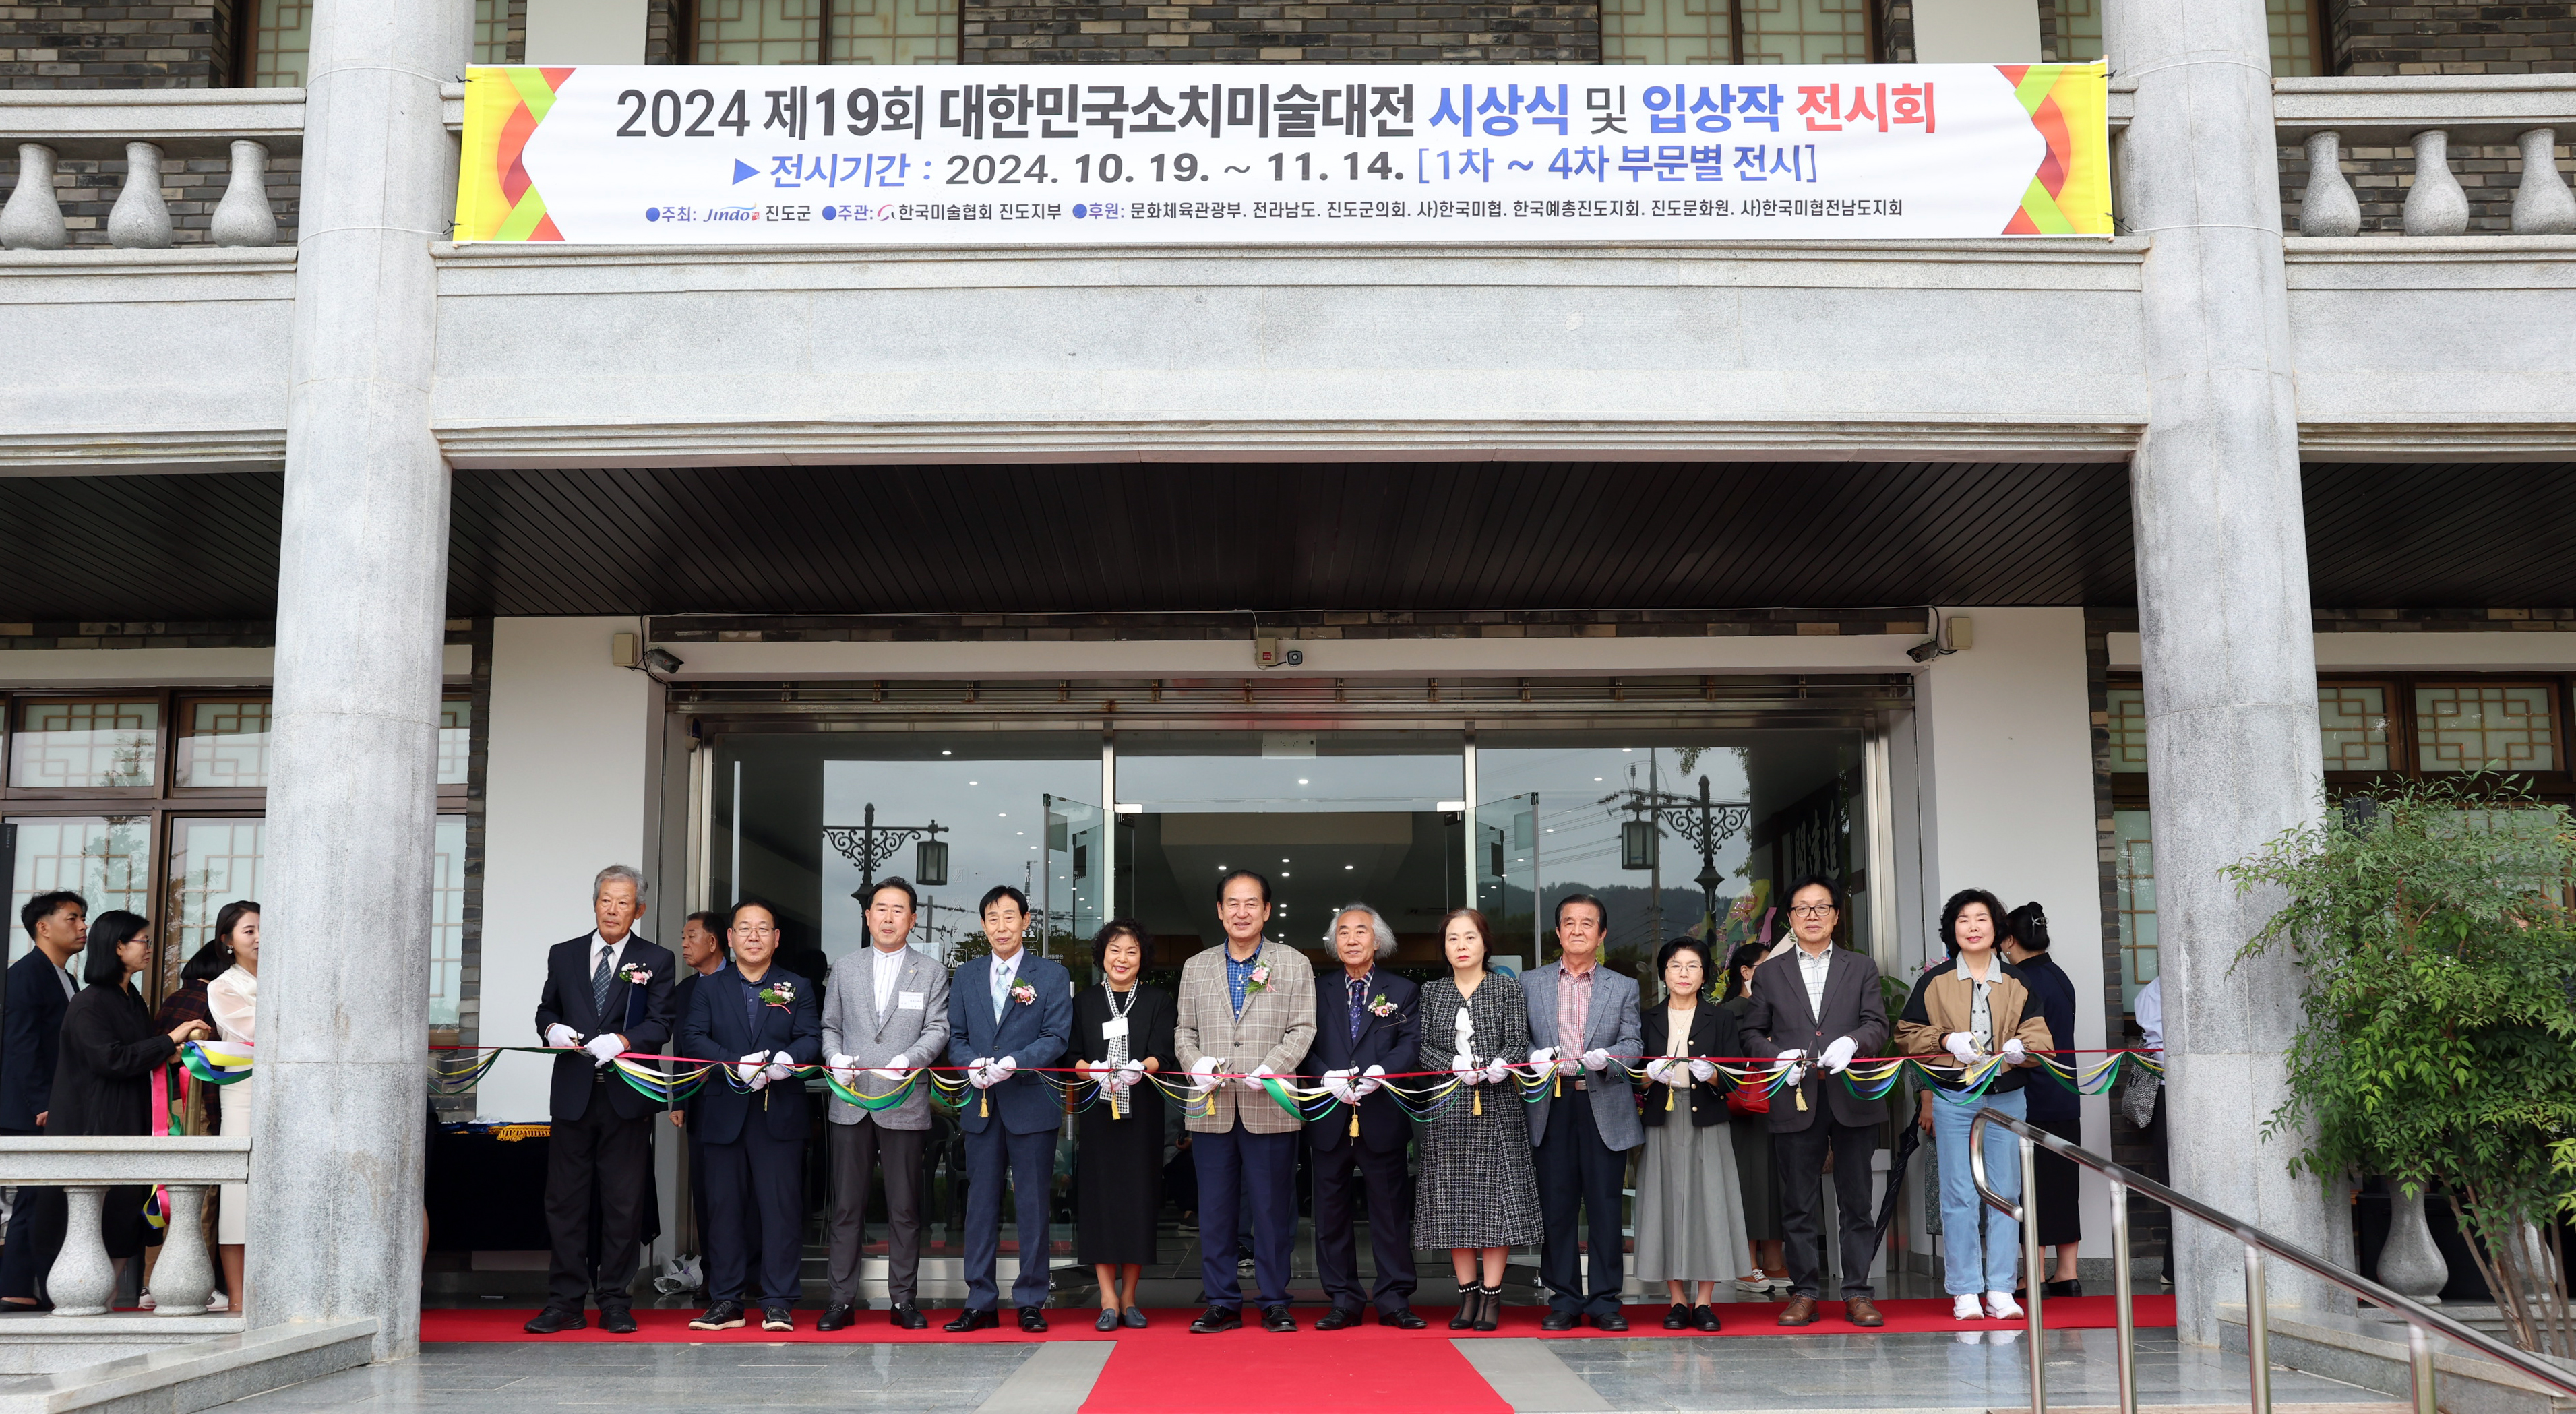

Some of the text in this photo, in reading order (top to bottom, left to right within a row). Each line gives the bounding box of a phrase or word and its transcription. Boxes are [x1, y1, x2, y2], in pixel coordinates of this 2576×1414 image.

[616, 82, 1936, 141] 2024 제19회 대한민국소치미술대전 시상식 및 입상작 전시회
[770, 153, 911, 188] 전시기간
[946, 154, 1058, 185] 2024.
[1075, 153, 1134, 183] 10.
[1150, 152, 1209, 182] 19.
[1268, 152, 1328, 181] 11.
[1343, 151, 1404, 181] 14.
[1419, 147, 1495, 184] [1차
[1547, 144, 1610, 183] 4차
[1618, 144, 1723, 183] 부문별
[1733, 144, 1817, 183] 전시]
[661, 206, 696, 222] 주최:
[702, 208, 750, 222] Jindo
[765, 205, 811, 222] 진도군
[838, 205, 873, 222] 주관:
[898, 203, 992, 221] 한국미술협회
[999, 203, 1062, 220] 진도지부
[1088, 202, 1124, 220] 후원:
[1130, 202, 1246, 219] 문화체육관광부.
[1253, 202, 1321, 218] 전라남도.
[1327, 200, 1411, 218] 진도군의회.
[1417, 199, 1507, 218] 사)한국미협.
[1513, 199, 1645, 218] 한국예총진도지회.
[1651, 199, 1734, 217] 진도문화원.
[1740, 199, 1902, 217] 사)한국미협전남도지회
